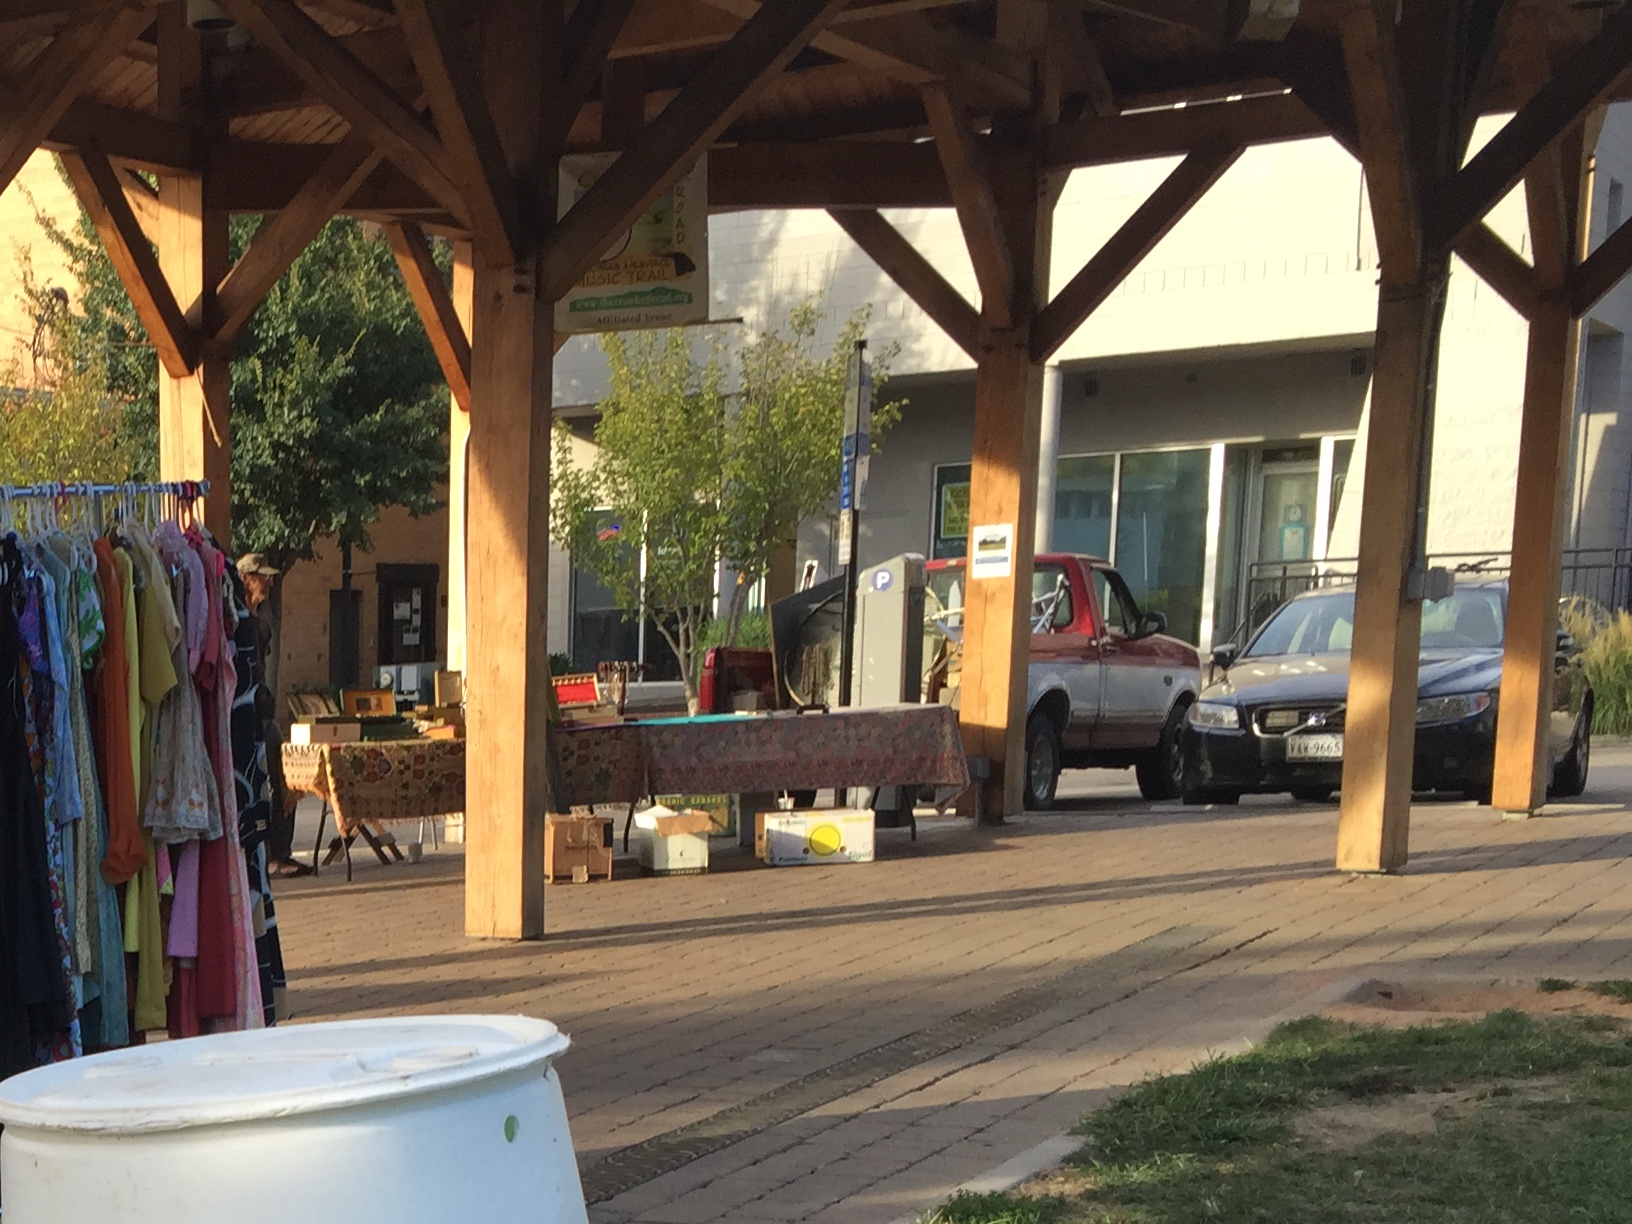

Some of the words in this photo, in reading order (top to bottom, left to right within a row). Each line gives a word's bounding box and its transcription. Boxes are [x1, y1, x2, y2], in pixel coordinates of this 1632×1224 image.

[578, 270, 621, 288] USIC
[627, 267, 670, 284] TRAIL
[597, 313, 641, 325] Affiliated
[876, 571, 890, 589] P
